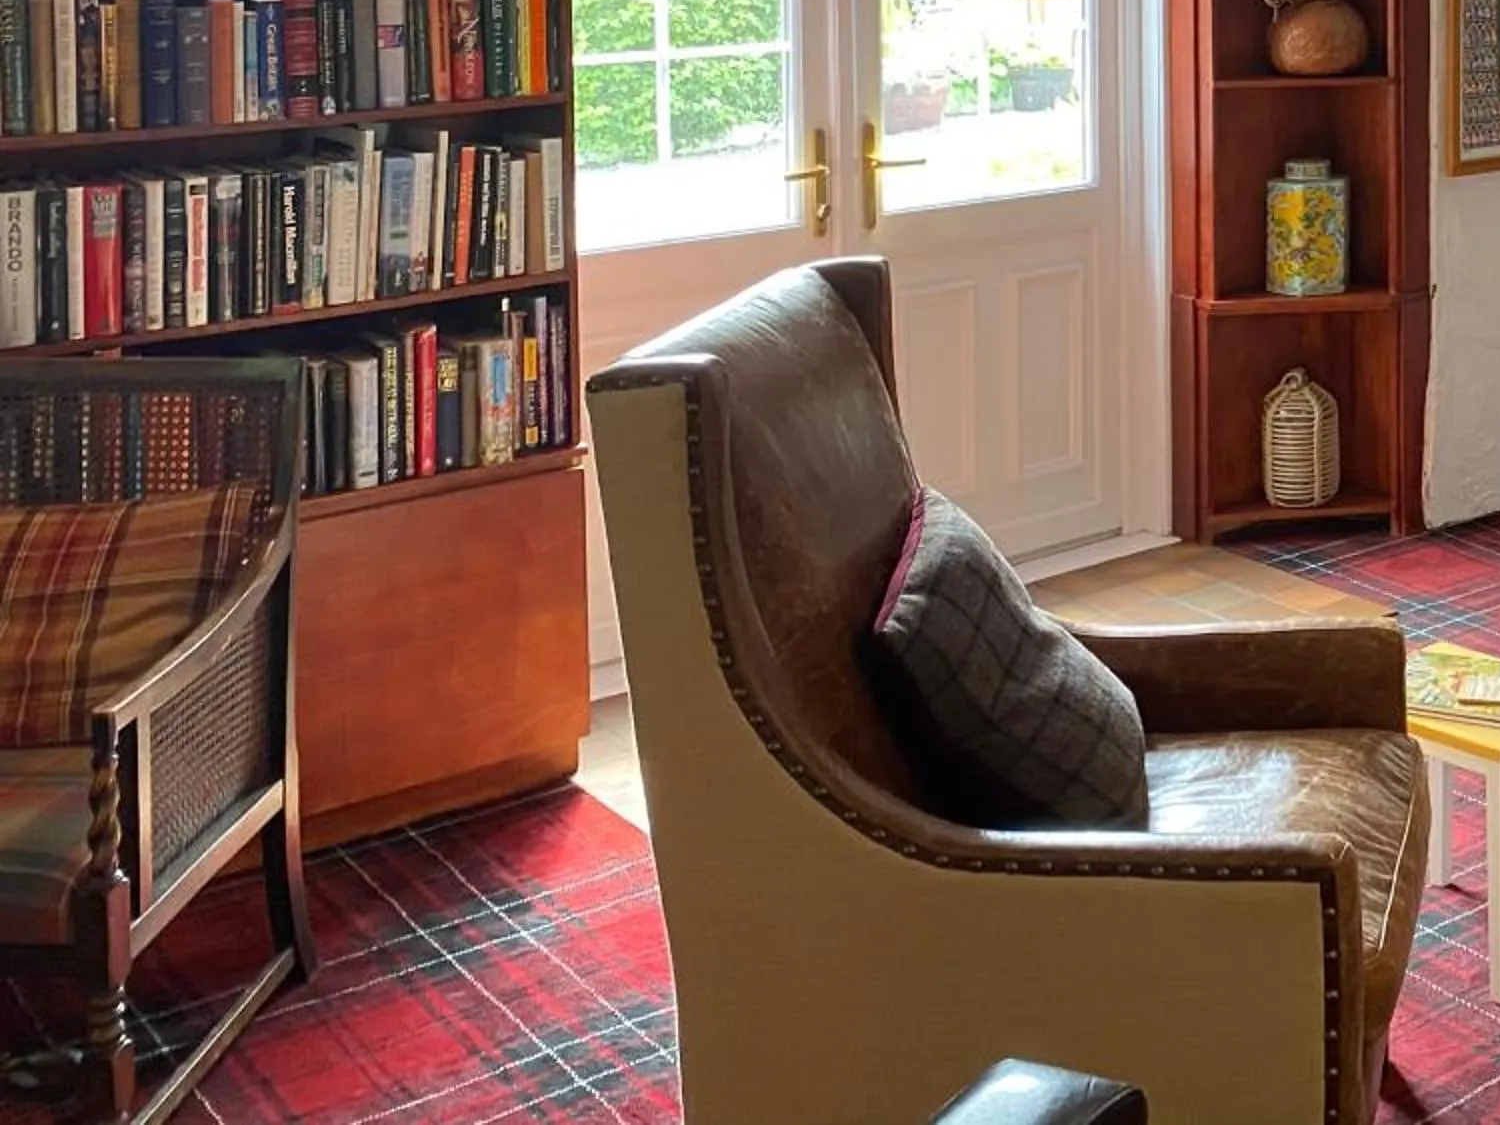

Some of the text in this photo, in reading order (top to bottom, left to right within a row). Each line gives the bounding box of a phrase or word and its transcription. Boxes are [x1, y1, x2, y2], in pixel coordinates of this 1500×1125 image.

[266, 24, 280, 92] Great Britain
[8, 196, 23, 273] BRANDO
[283, 186, 298, 285] Harold Macmillan
